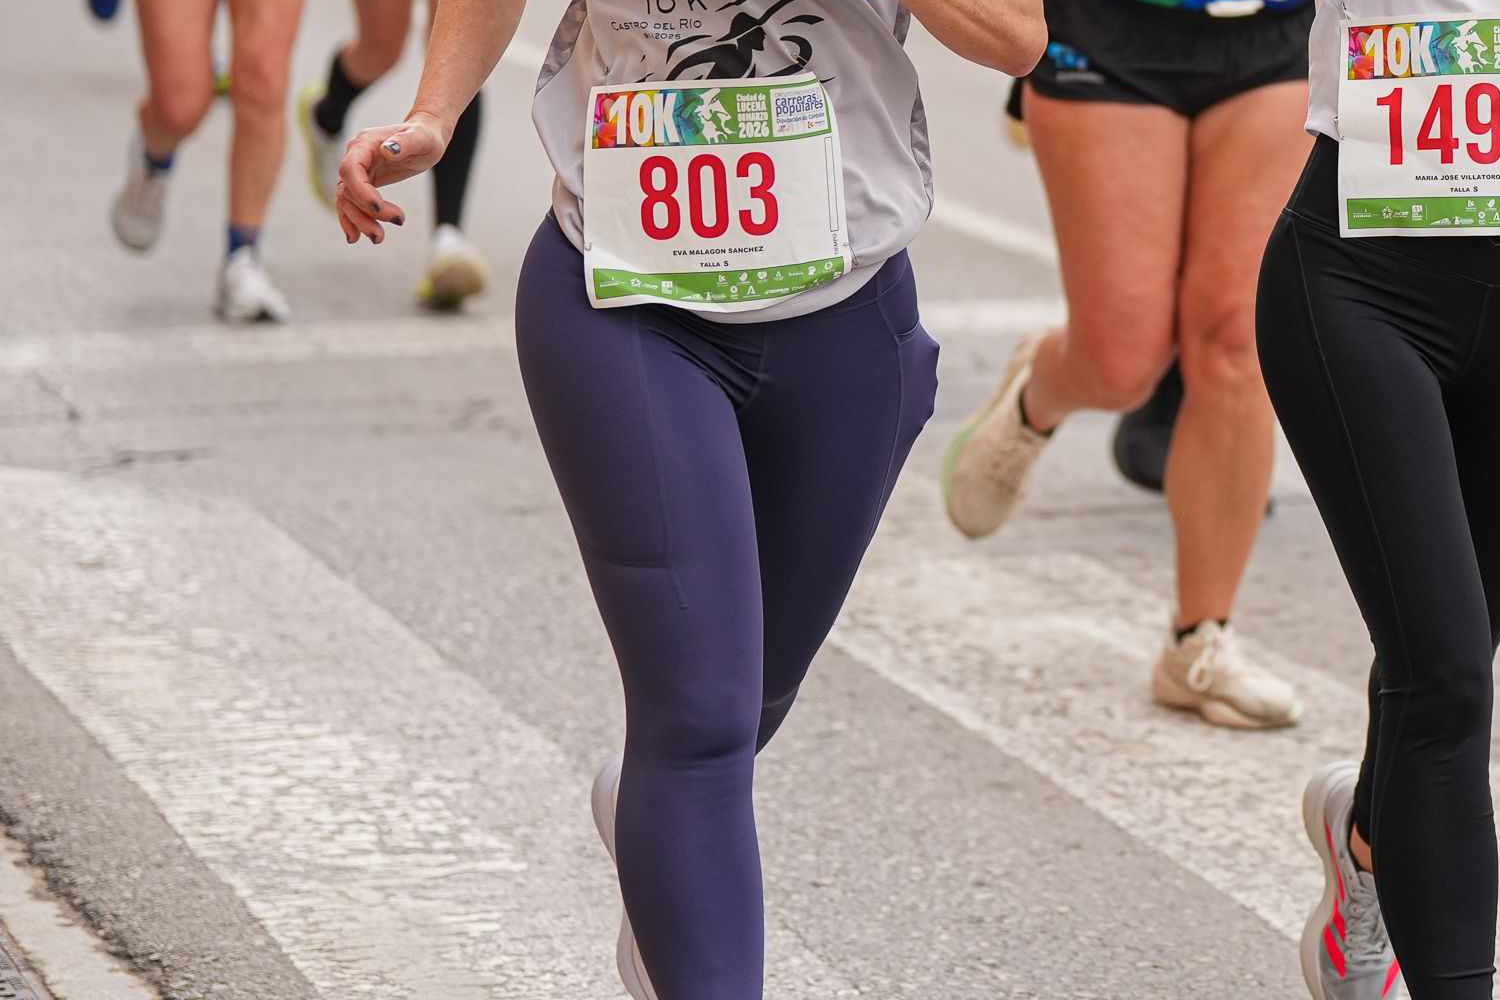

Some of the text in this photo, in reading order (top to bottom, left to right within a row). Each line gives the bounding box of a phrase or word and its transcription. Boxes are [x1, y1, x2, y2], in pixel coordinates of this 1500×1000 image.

[1365, 25, 1436, 77] 10K
[758, 93, 766, 101] de
[775, 93, 816, 107] carreras
[737, 101, 766, 112] LUCENA
[776, 99, 824, 117] populares
[608, 92, 680, 145] 10K
[738, 121, 769, 138] 2026
[639, 152, 779, 240] 803
[689, 248, 727, 256] MALAGON
[728, 246, 764, 254] SANCHEZ
